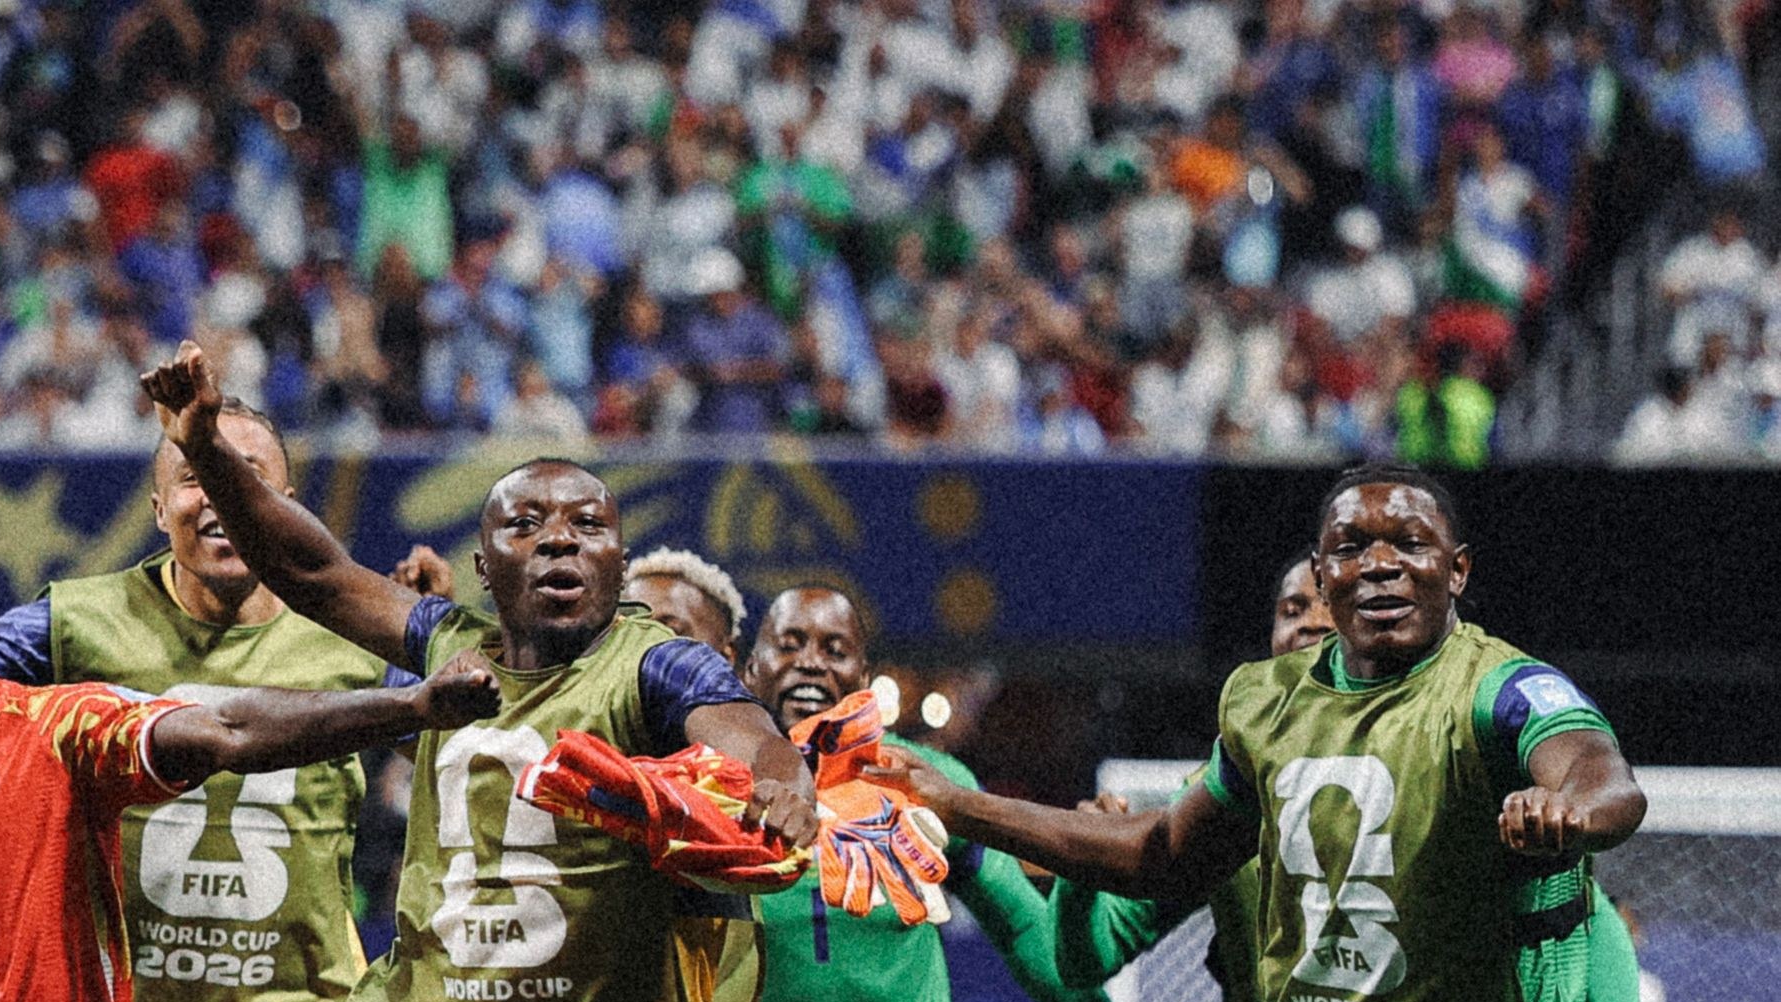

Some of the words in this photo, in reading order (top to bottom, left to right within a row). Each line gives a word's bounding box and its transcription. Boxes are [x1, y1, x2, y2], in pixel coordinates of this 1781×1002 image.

[182, 873, 248, 898] FIFA
[137, 919, 228, 948] WORLD
[232, 930, 281, 952] CUP
[463, 919, 527, 944] FIFA
[135, 945, 276, 987] 2026
[443, 976, 514, 1001] WORLD
[518, 977, 574, 999] CUP
